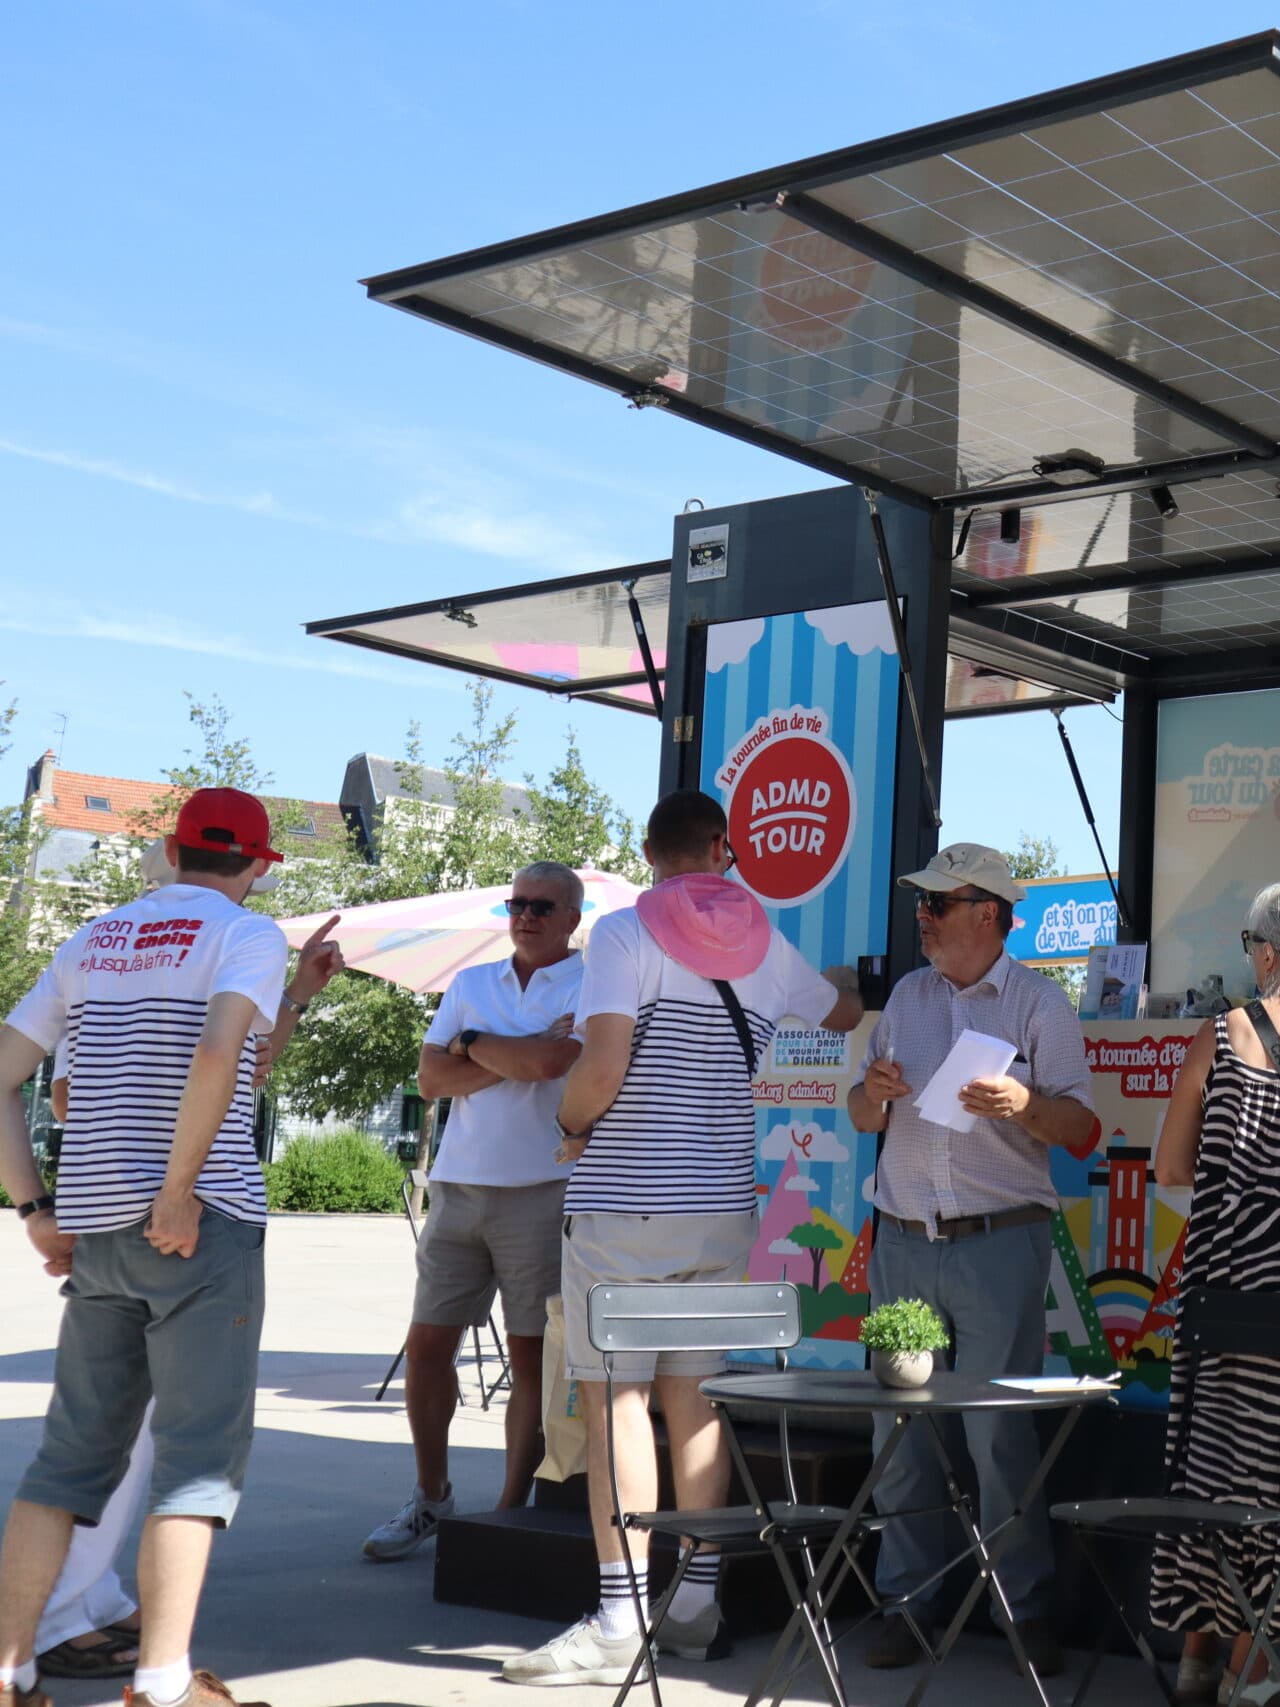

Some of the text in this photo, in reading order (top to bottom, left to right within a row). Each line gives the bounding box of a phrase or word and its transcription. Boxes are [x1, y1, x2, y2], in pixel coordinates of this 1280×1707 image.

[720, 713, 822, 785] La tournée fin de vie
[751, 778, 831, 816] ADMD
[749, 825, 825, 858] TOUR
[1046, 904, 1117, 927] et si on pa
[90, 919, 203, 936] mon corps
[1039, 927, 1055, 949] de
[84, 931, 196, 951] mon choix
[776, 1040, 845, 1048] POUR LE DROIT
[777, 1030, 846, 1039] ASSOCIATION
[776, 1048, 786, 1056] DE
[788, 1048, 821, 1056] MOURIR
[1100, 1043, 1157, 1066] tournée
[1160, 1043, 1187, 1066] d'ét
[1126, 1073, 1152, 1091] sur
[1153, 1068, 1169, 1091] la
[789, 1081, 835, 1101] admd.org
